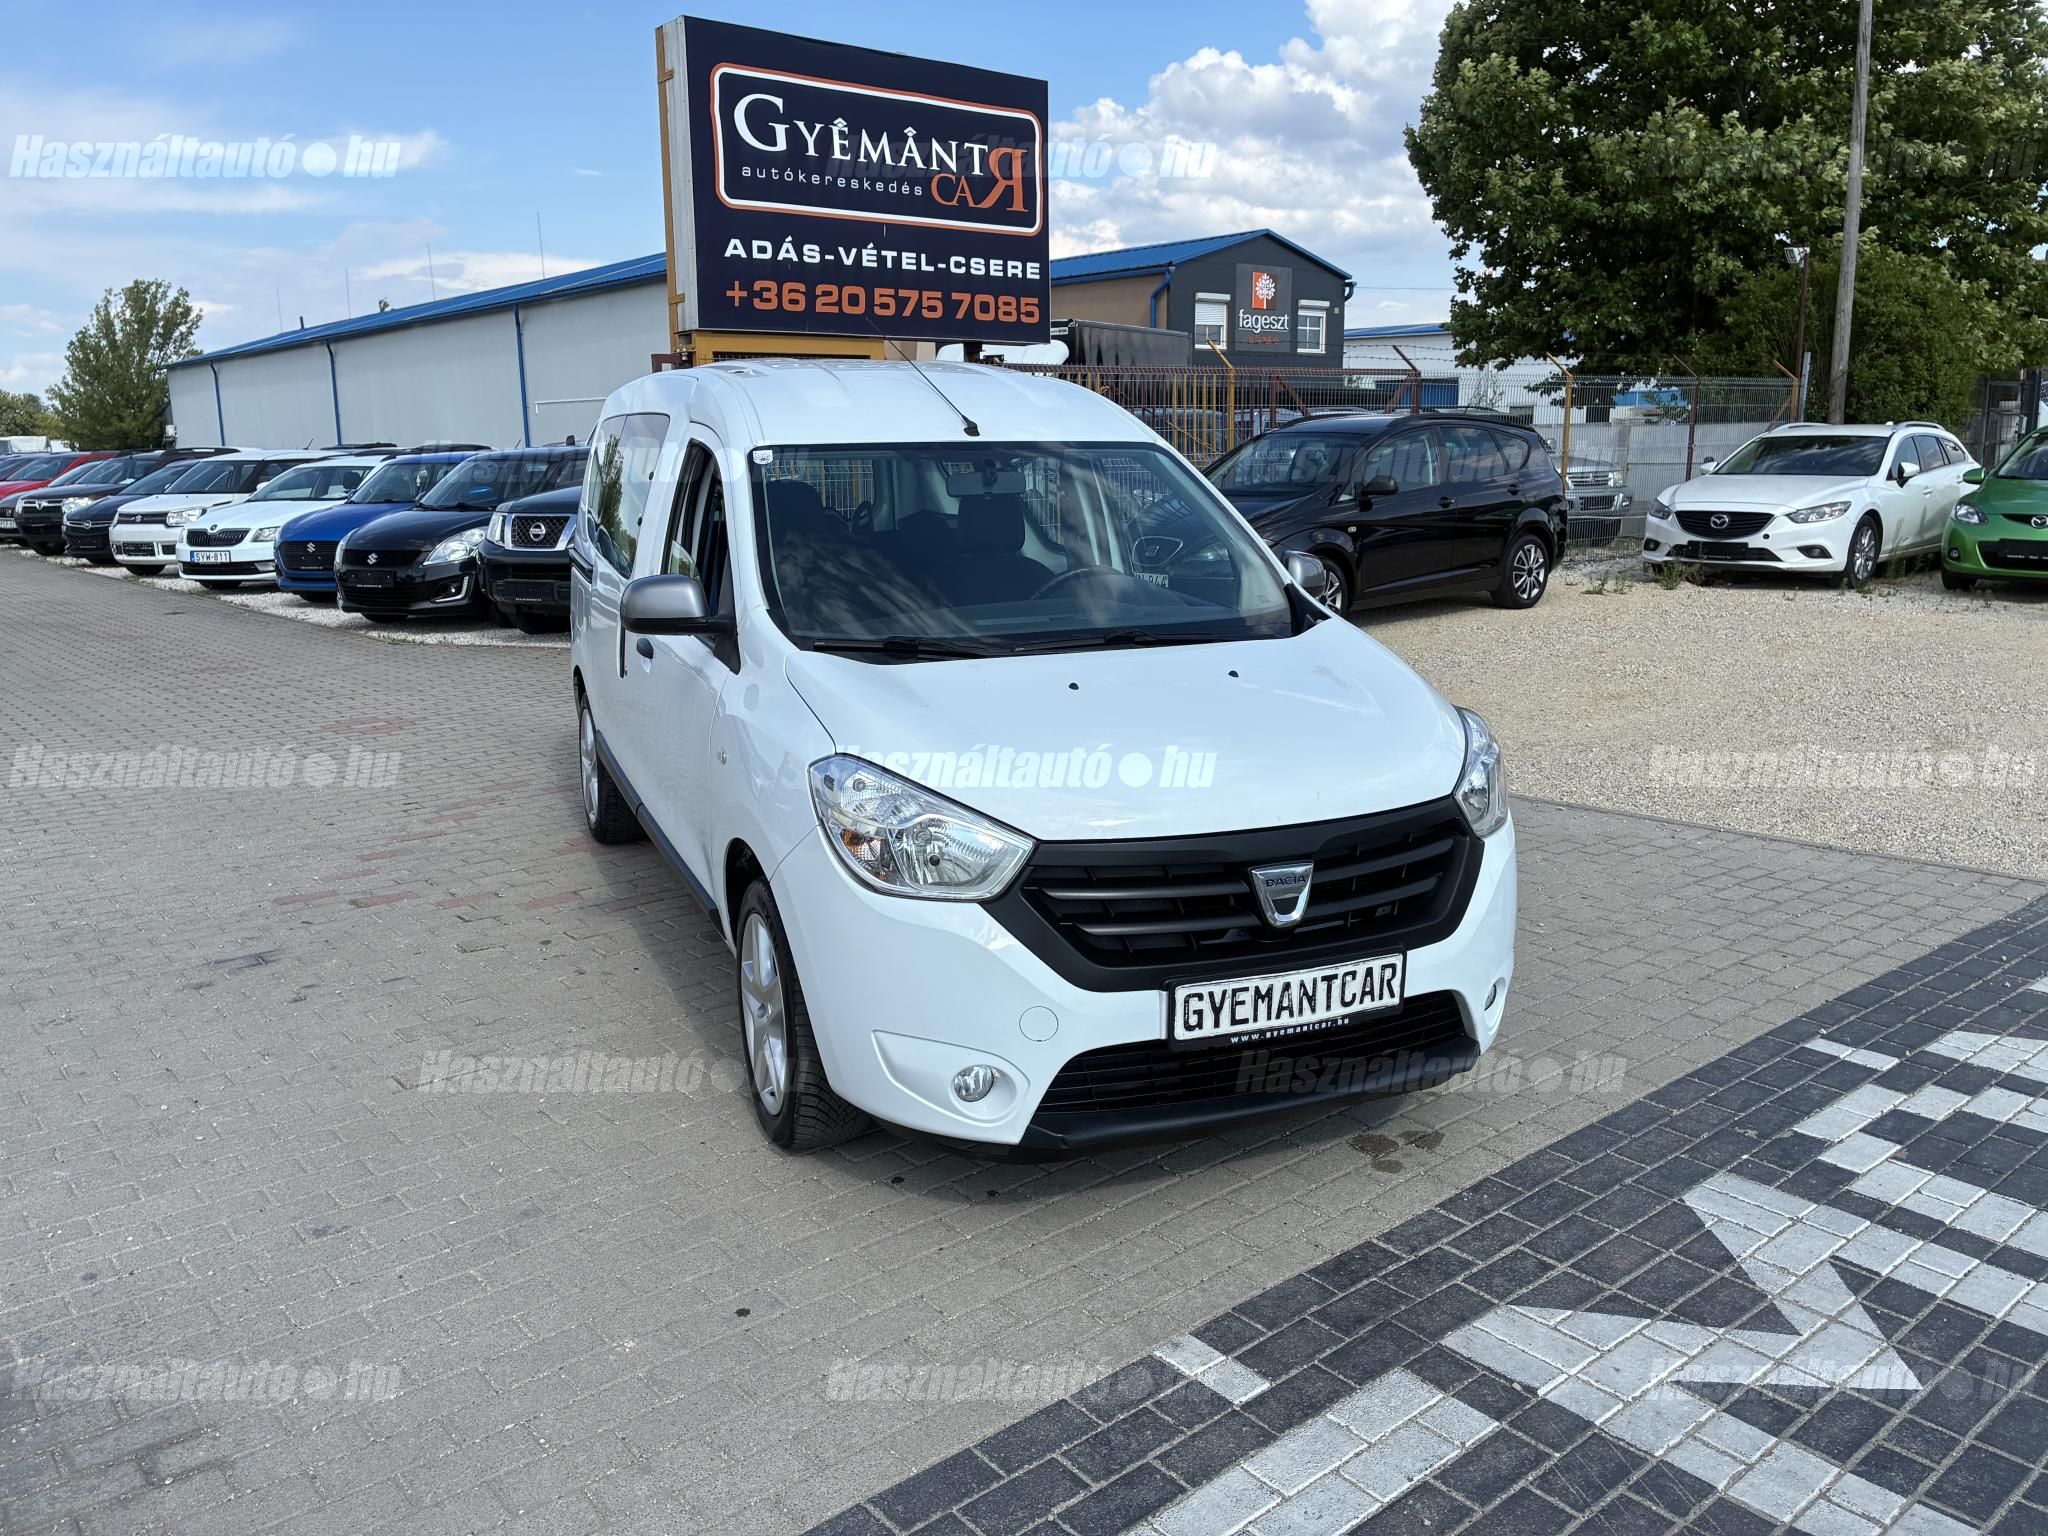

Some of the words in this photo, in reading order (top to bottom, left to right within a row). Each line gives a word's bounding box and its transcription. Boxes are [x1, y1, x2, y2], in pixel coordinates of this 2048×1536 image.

[742, 165, 923, 196] autókereskedés
[724, 235, 1041, 280] ADÁS-VÉTEL-CSERE
[726, 280, 806, 312] +36
[815, 284, 866, 316] 20
[873, 287, 943, 319] 575
[951, 292, 1041, 324] 7085
[1238, 309, 1289, 333] fageszt
[195, 553, 228, 561] SYW-811
[1265, 875, 1306, 887] DACIA
[1183, 962, 1398, 1032] GYEMANTCAR
[1230, 1017, 1350, 1044] www.gyemantcar.hu
